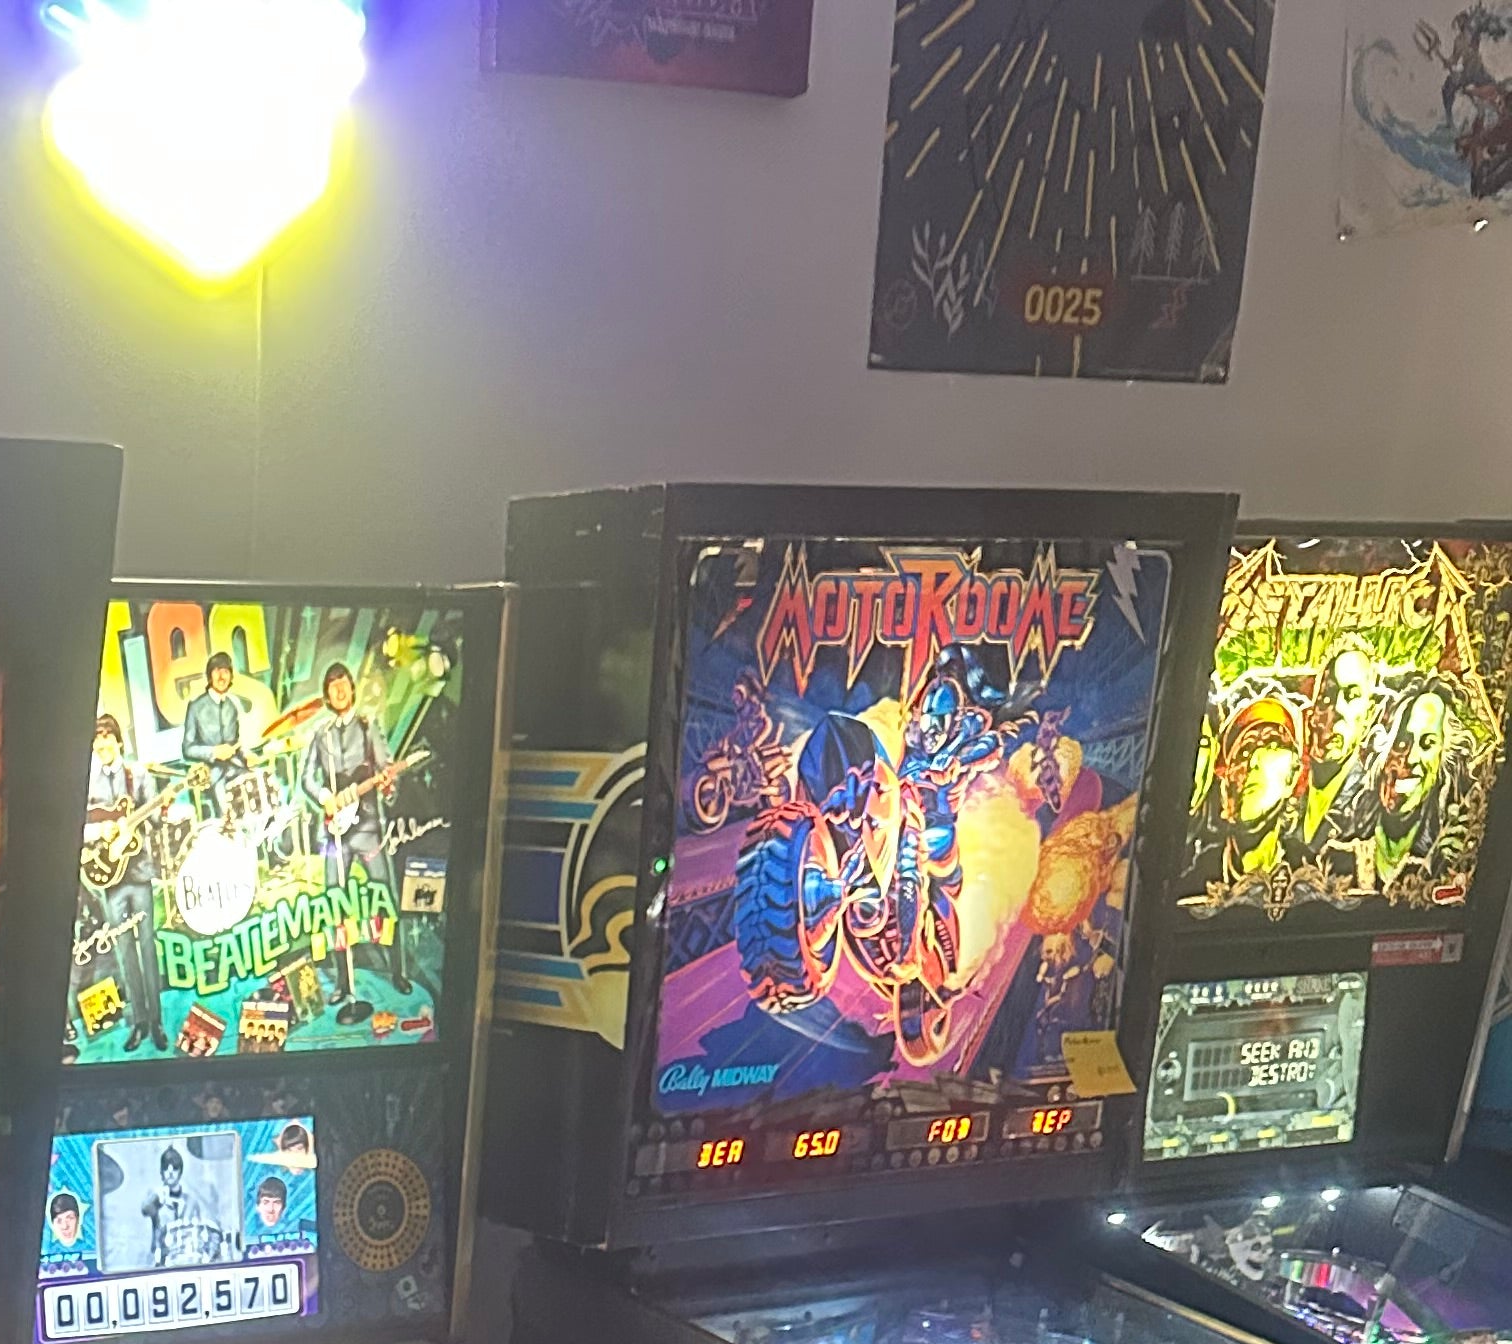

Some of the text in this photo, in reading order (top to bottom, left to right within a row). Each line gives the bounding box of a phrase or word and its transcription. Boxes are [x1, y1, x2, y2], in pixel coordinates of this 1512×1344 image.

[1024, 284, 1103, 326] 0025
[1240, 1041, 1281, 1065] SEEK
[659, 1063, 780, 1097] Bally MIDWAY
[56, 1272, 288, 1329] 00,092,570
